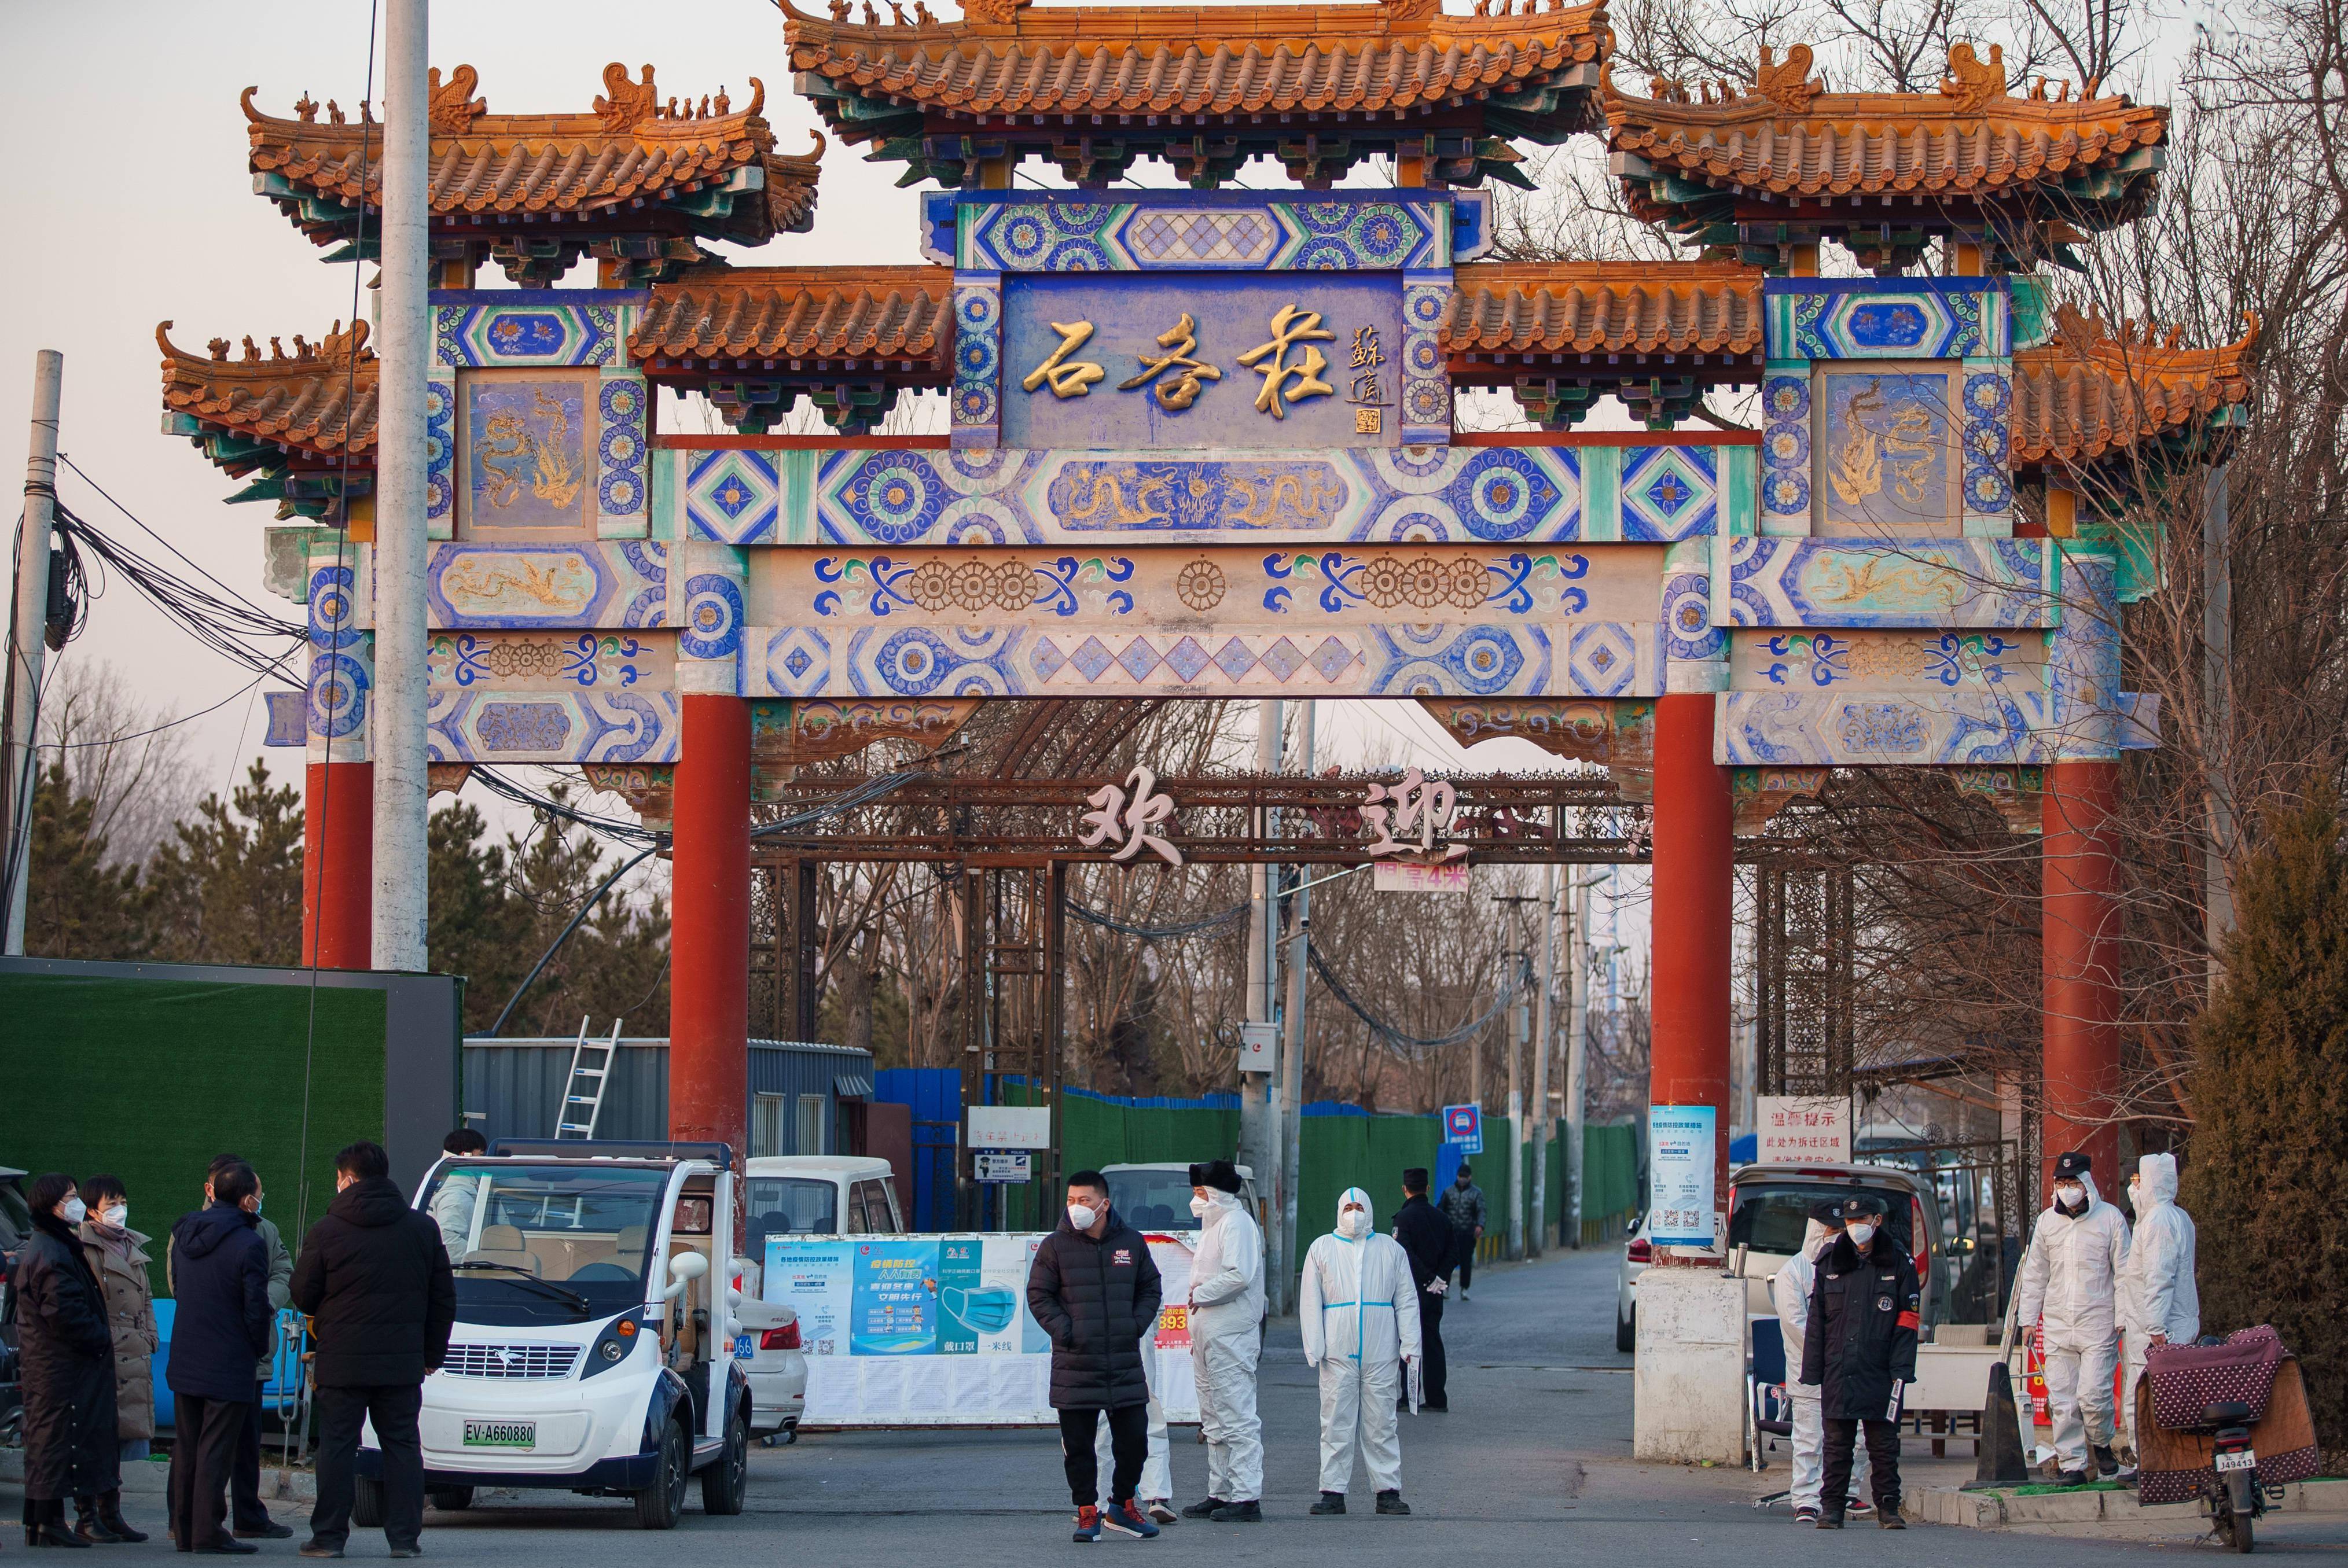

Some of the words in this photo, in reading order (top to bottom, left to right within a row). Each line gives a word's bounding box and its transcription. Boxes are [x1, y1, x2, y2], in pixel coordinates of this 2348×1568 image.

[1772, 1111, 1835, 1127] 温馨提示
[1767, 1136, 1839, 1148] 此处为拆迁区域
[870, 1260, 917, 1268] 疫情防控
[878, 1269, 922, 1279] 人人有责
[870, 1283, 914, 1291] 喜迎冬奥
[879, 1293, 922, 1302] 文明先行
[944, 1341, 975, 1352] 戴口罩
[981, 1341, 1012, 1352] 一米线
[466, 1424, 533, 1442] EV·A660880
[2224, 1452, 2246, 1461] 北京
[2220, 1459, 2253, 1470] J49413
